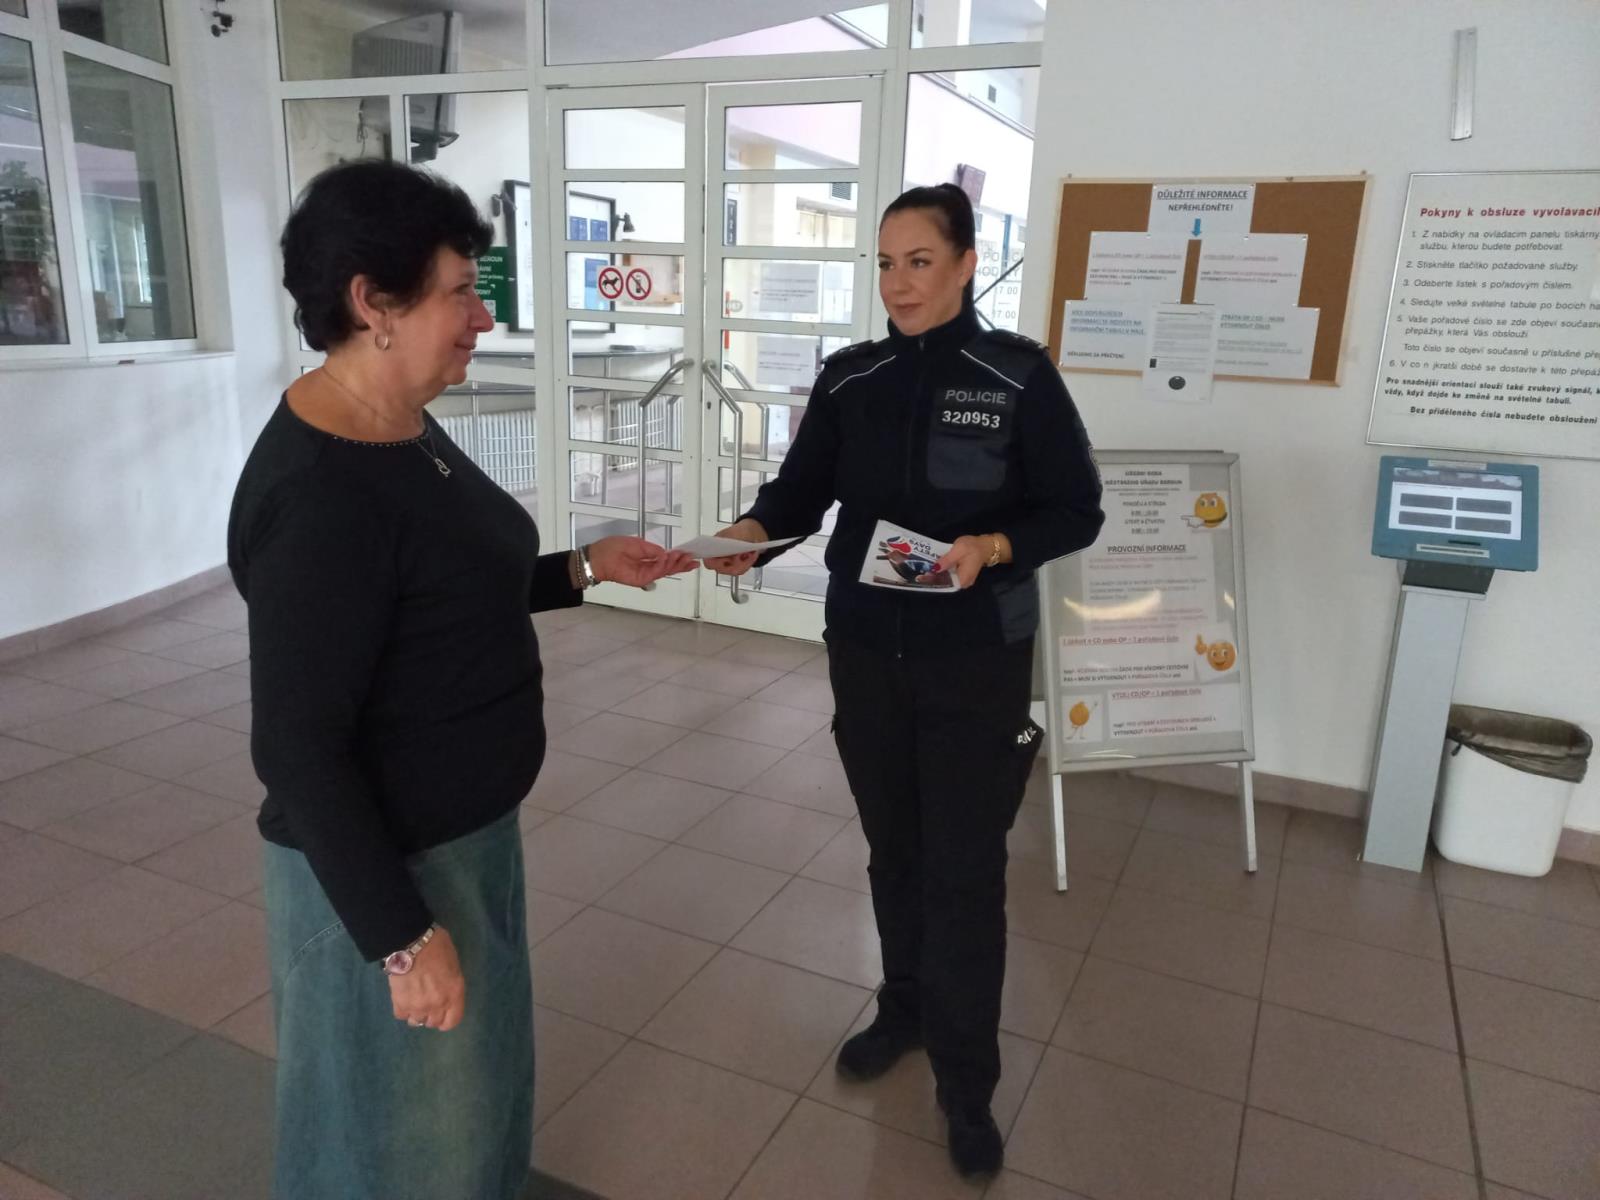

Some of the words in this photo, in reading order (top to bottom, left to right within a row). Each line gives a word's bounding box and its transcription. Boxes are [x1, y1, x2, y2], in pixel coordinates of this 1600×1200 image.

[1157, 188, 1195, 199] DŮLEŽITÉ
[1197, 189, 1248, 199] INFORMACE
[1168, 202, 1233, 212] NEPŘEHLÉDNĚTE!
[945, 389, 1007, 404] POLICIE
[942, 410, 1001, 428] 320953
[1107, 544, 1145, 553] PROVOZNÍ
[1146, 544, 1186, 552] INFORMACE
